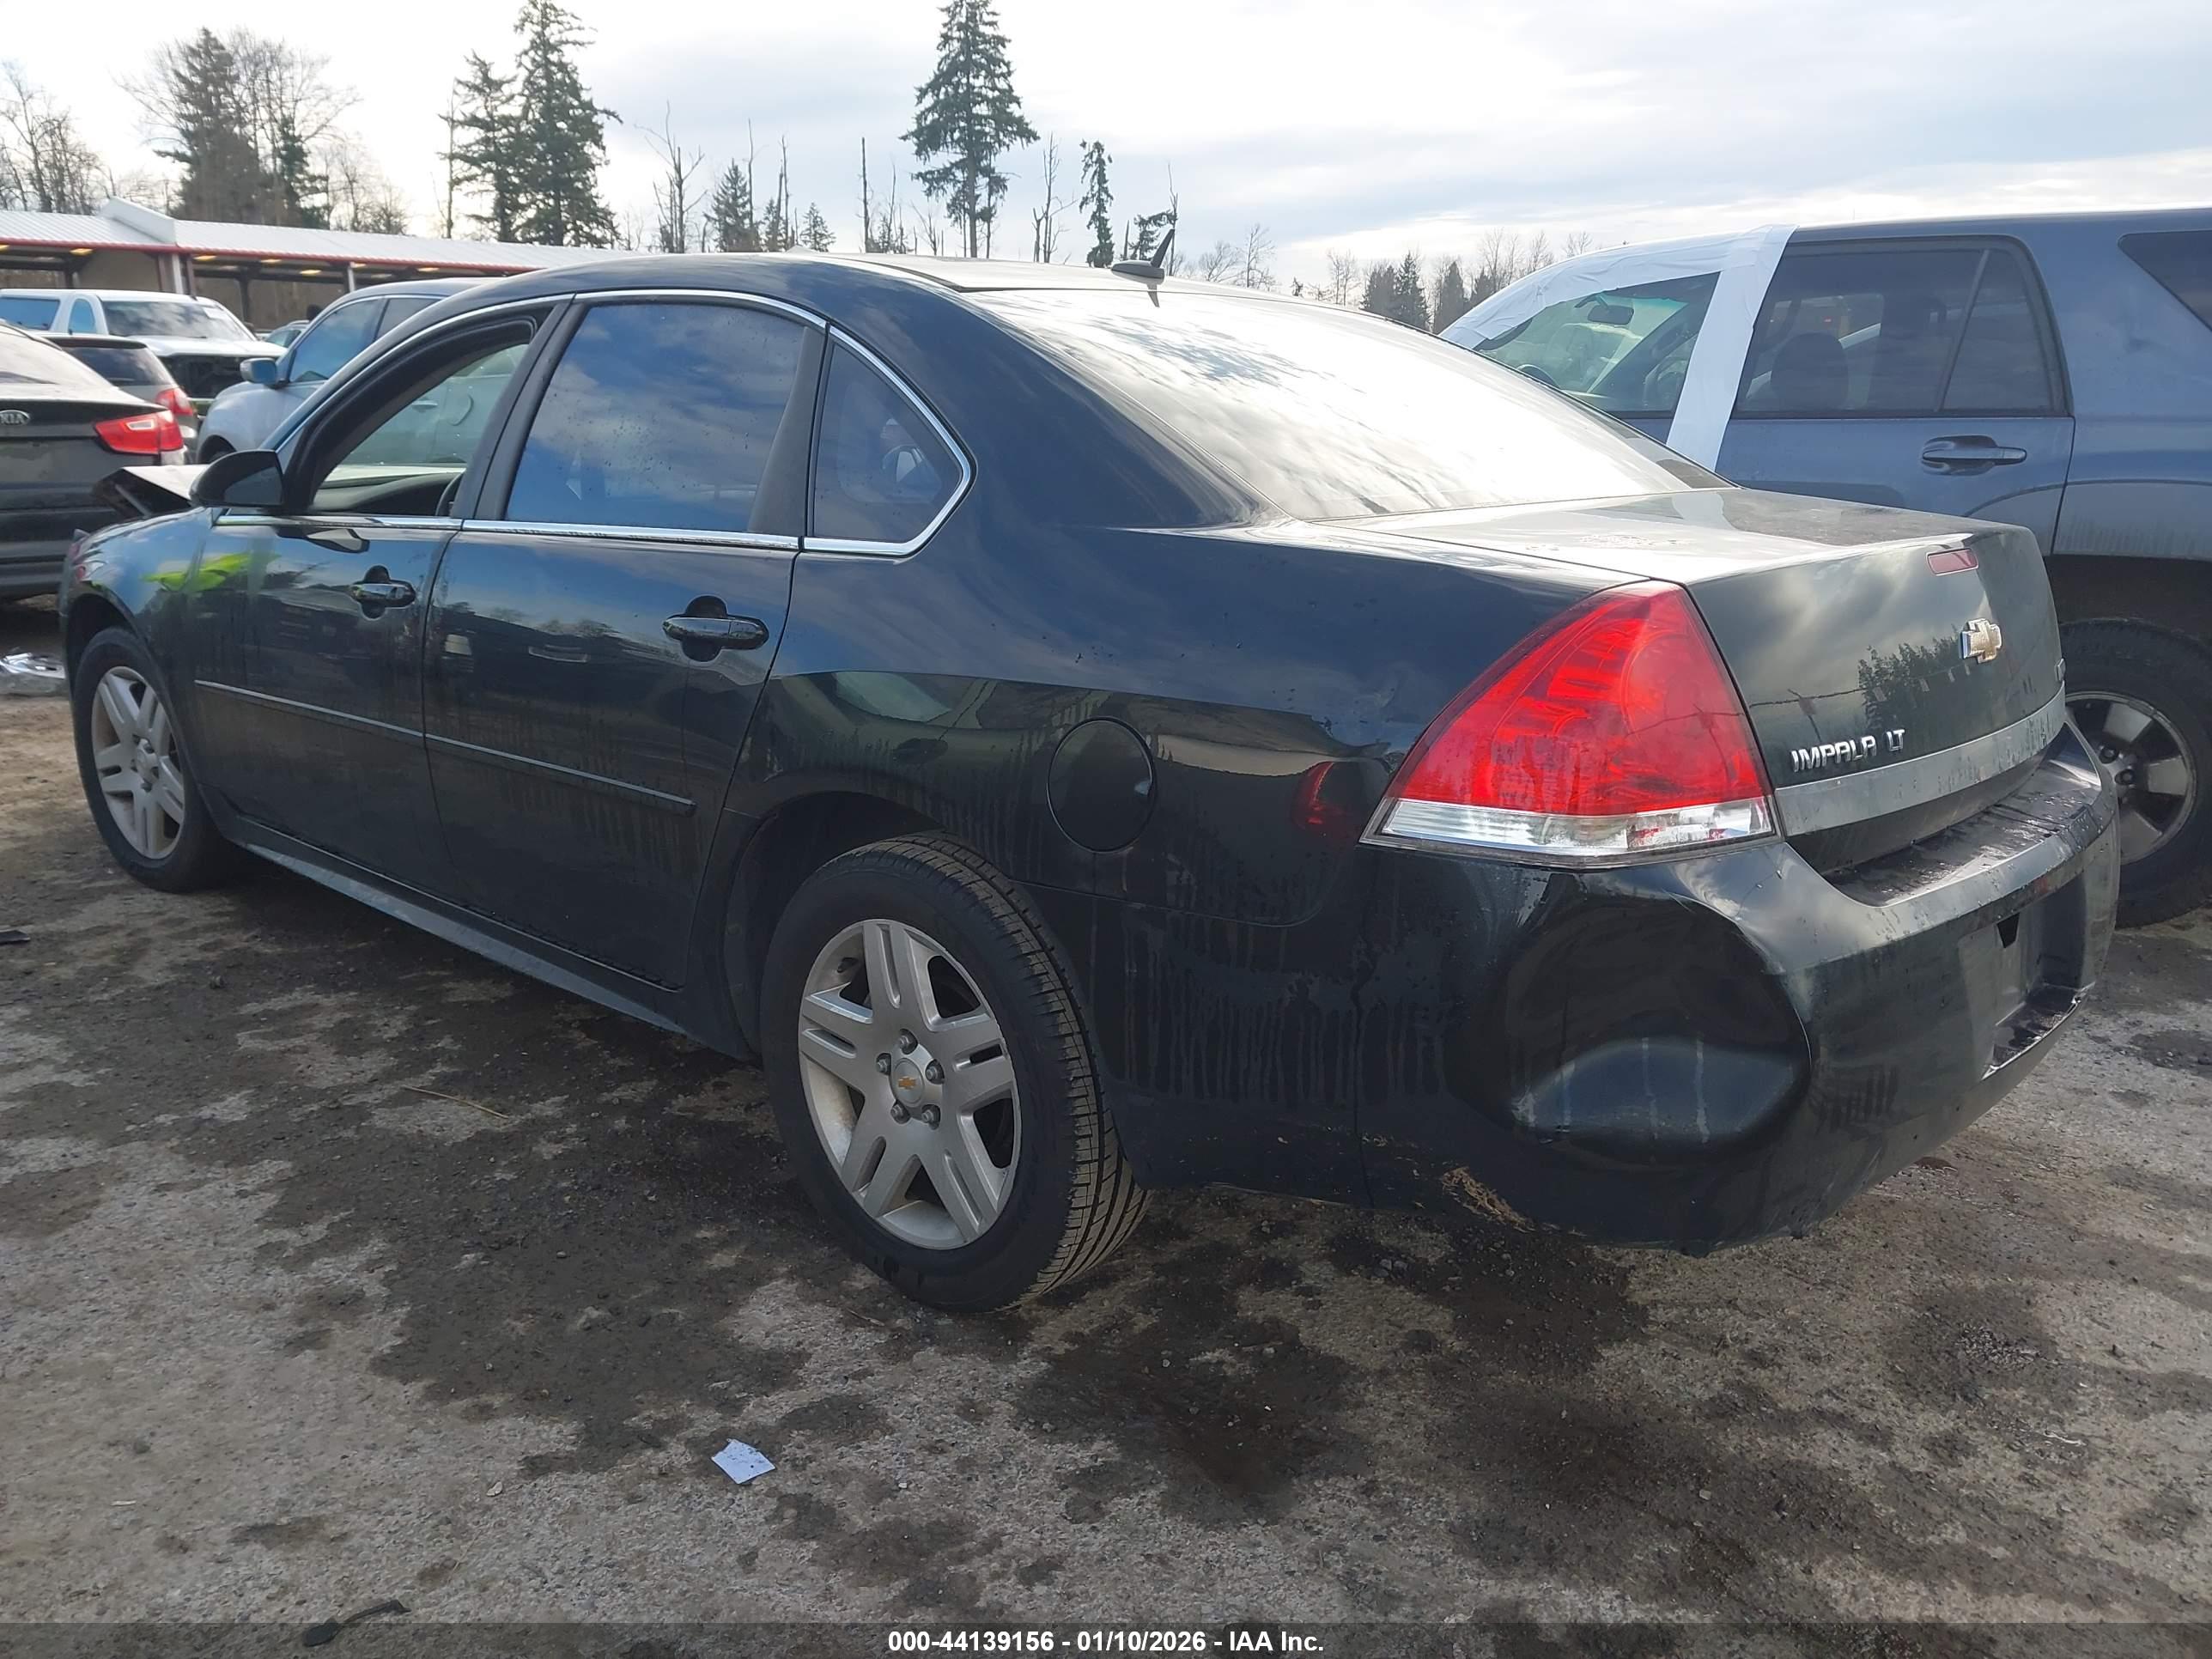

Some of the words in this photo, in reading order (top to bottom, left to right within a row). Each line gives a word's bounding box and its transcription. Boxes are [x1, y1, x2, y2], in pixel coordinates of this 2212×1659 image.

[0, 413, 25, 424] KIA
[1791, 735, 1877, 773] IMPALA
[1886, 729, 1905, 752] LT
